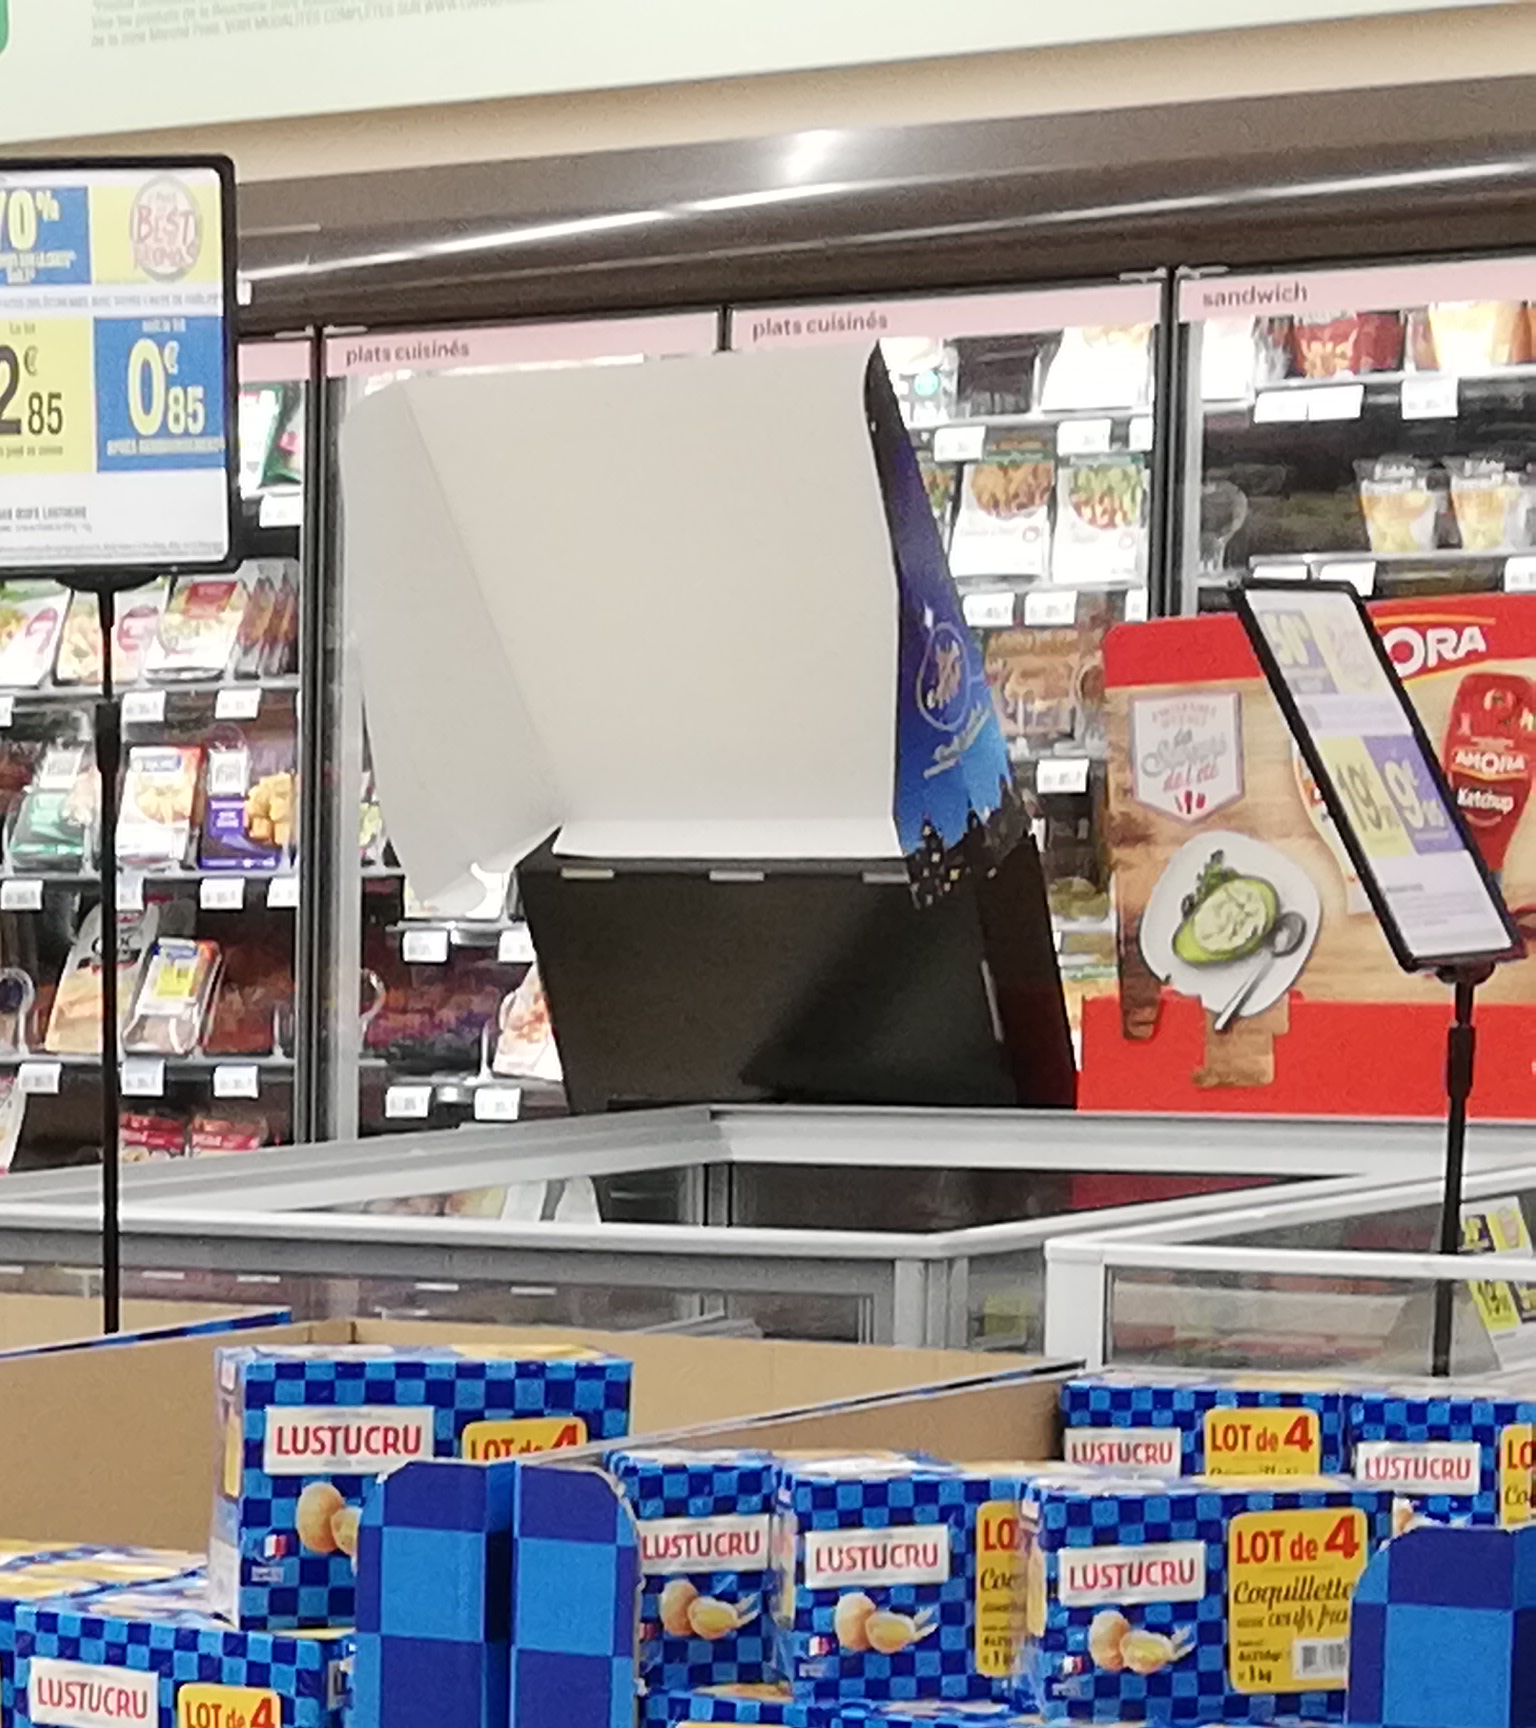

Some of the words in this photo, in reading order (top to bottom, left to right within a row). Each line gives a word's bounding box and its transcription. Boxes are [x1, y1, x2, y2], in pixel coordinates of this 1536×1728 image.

[1202, 280, 1309, 308] sandwich
[752, 317, 803, 342] plats
[806, 311, 889, 335] cuisinés
[345, 342, 391, 366] plats
[394, 338, 471, 361] cuisinés
[1383, 626, 1488, 677] ORA
[275, 1424, 423, 1457] LUSTUCRU
[1210, 1424, 1253, 1454] LOT
[1256, 1422, 1279, 1452] de
[1282, 1414, 1314, 1453] 4
[1069, 1440, 1175, 1466] LUSTUCRU
[1364, 1454, 1472, 1482] LUSTUCRU
[641, 1529, 761, 1561] LUSTUCRU
[1235, 1530, 1285, 1566] LOT
[1289, 1529, 1318, 1562] de
[1324, 1514, 1361, 1560] 4
[814, 1541, 940, 1574] LUSTUCRU
[1068, 1557, 1197, 1592] LUSTUCRU
[37, 1676, 148, 1720] LUSTUCRU
